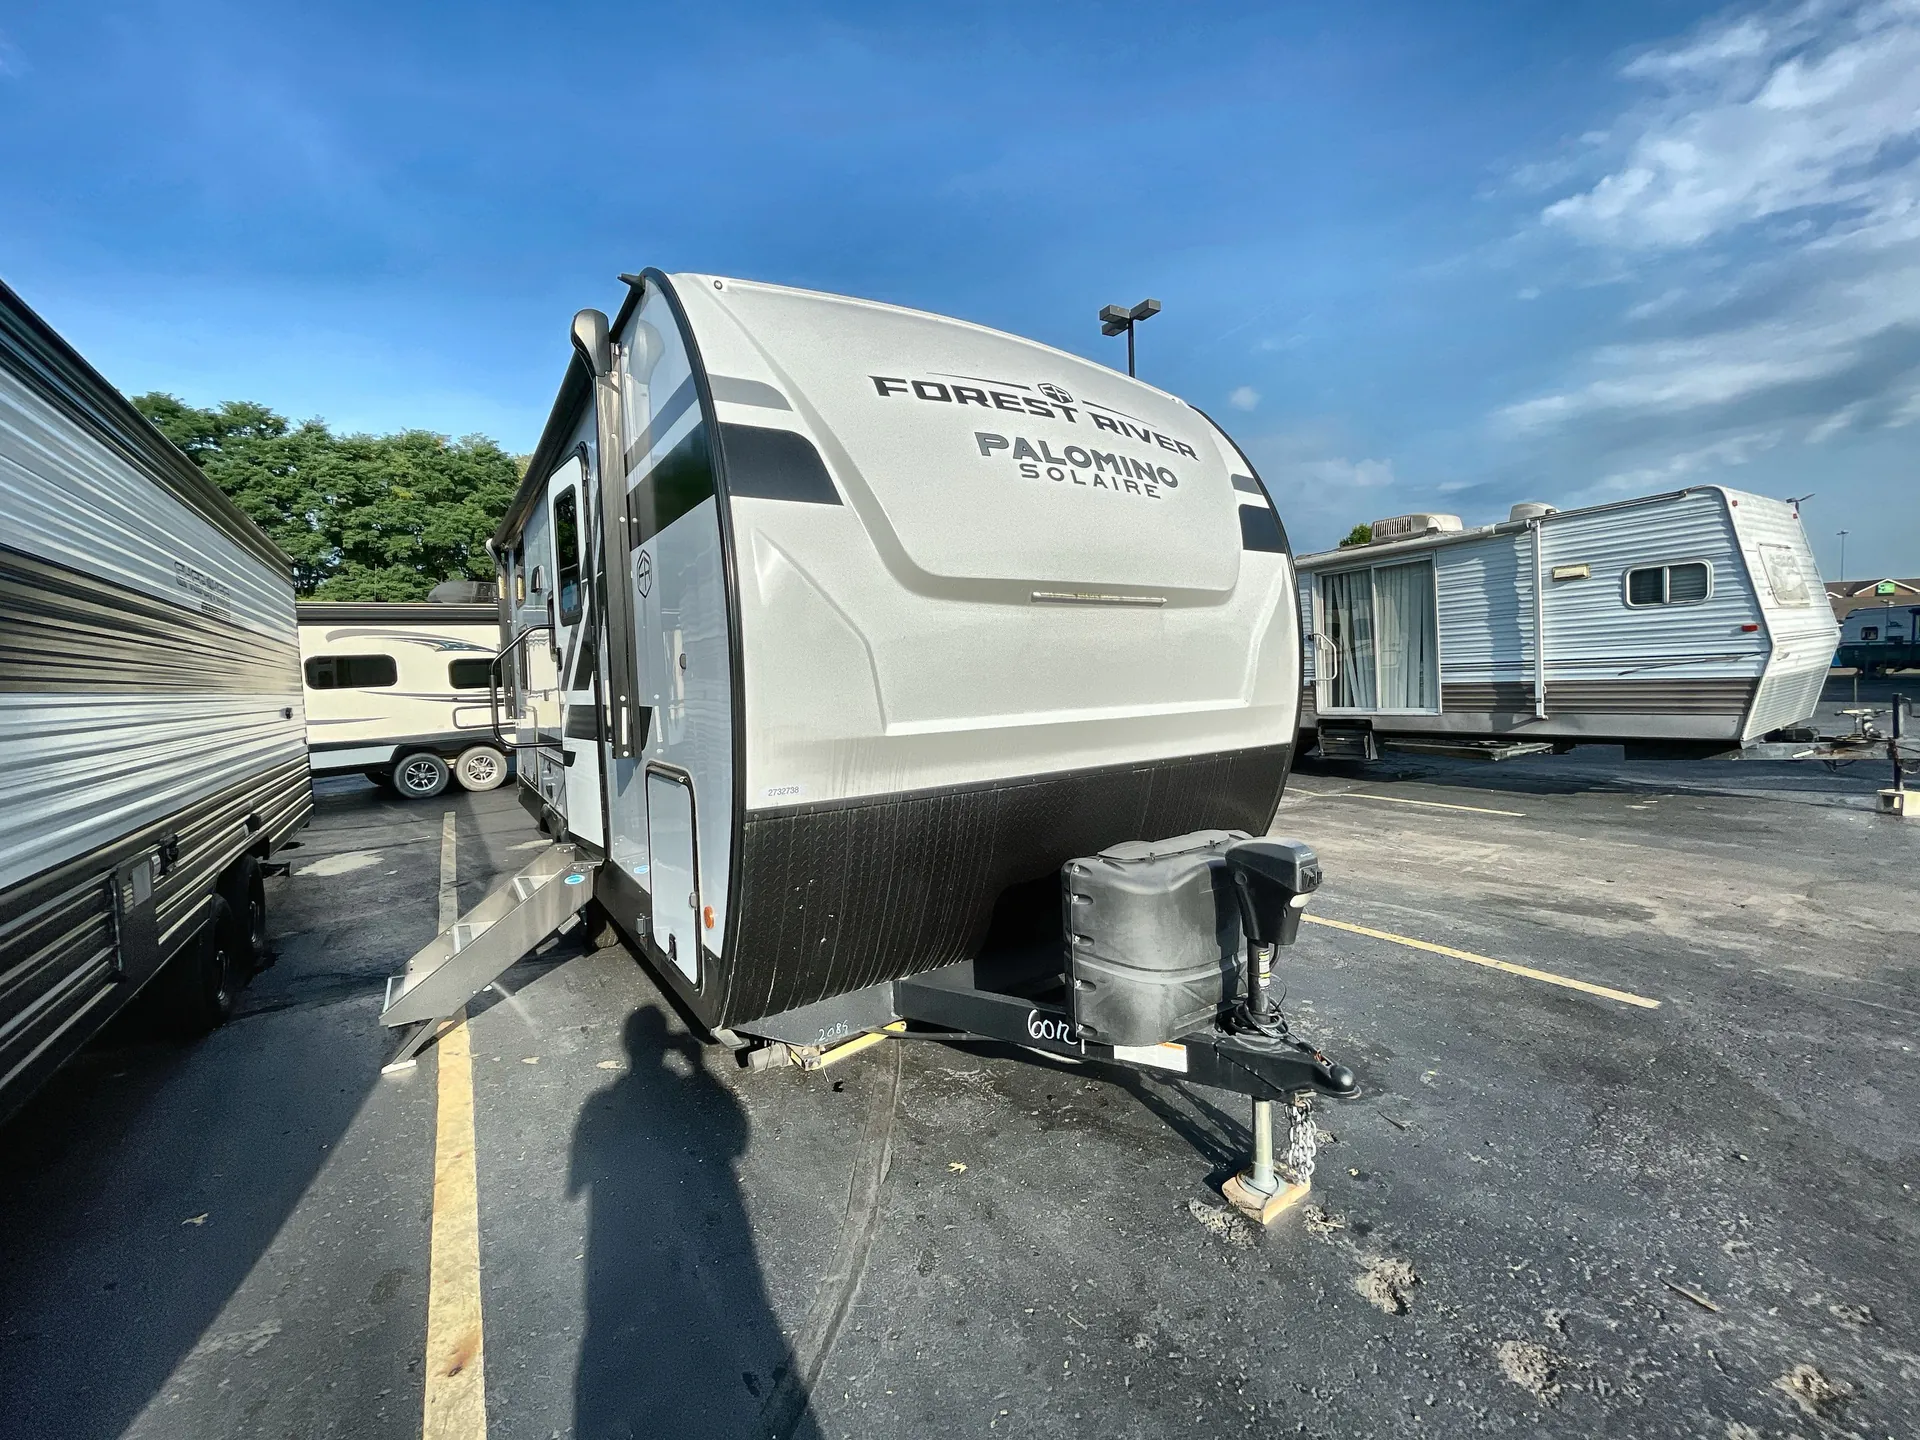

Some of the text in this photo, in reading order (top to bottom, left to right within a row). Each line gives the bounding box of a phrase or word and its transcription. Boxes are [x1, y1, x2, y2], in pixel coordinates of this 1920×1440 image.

[867, 375, 1200, 461] FOREST RIVER
[974, 431, 1179, 488] PALOMINO
[1019, 463, 1161, 499] SOLAIRE
[768, 786, 800, 796] 2732738
